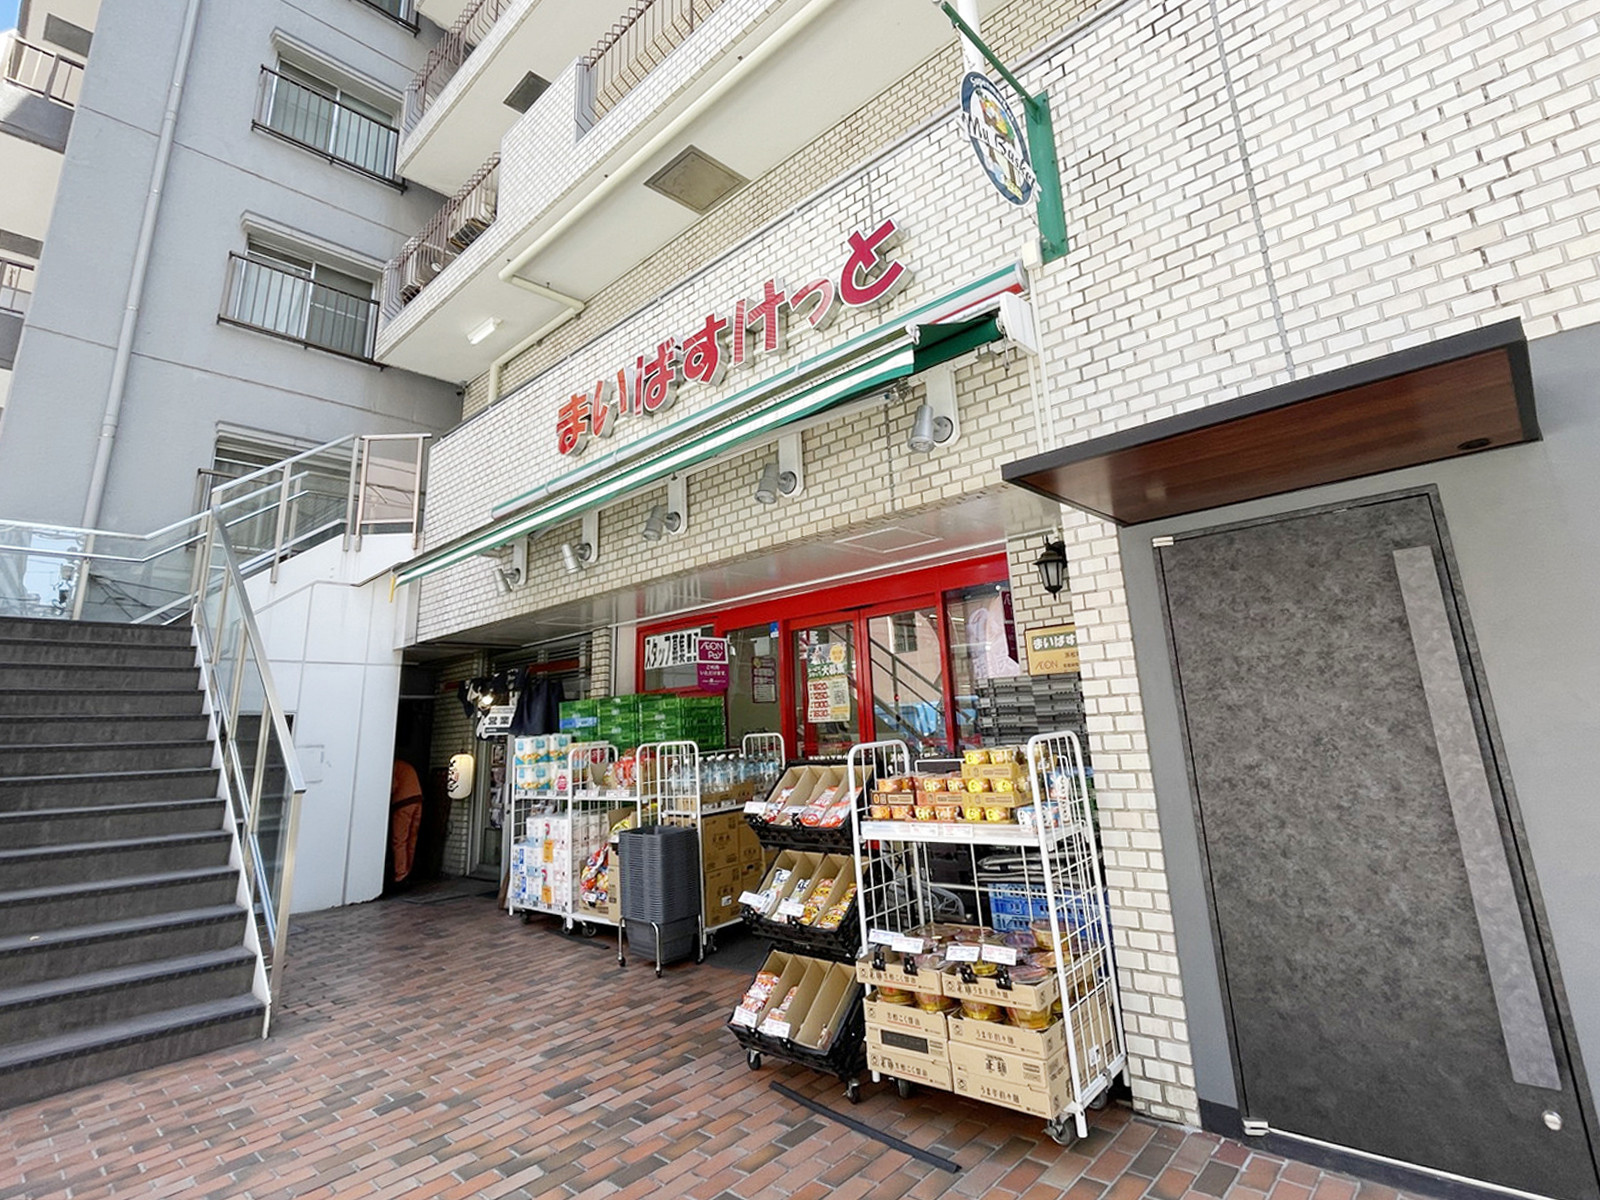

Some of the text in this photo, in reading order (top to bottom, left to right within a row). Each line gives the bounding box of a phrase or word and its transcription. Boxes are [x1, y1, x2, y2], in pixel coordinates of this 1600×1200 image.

[962, 112, 990, 146] My
[556, 218, 906, 455] まいばすけっと
